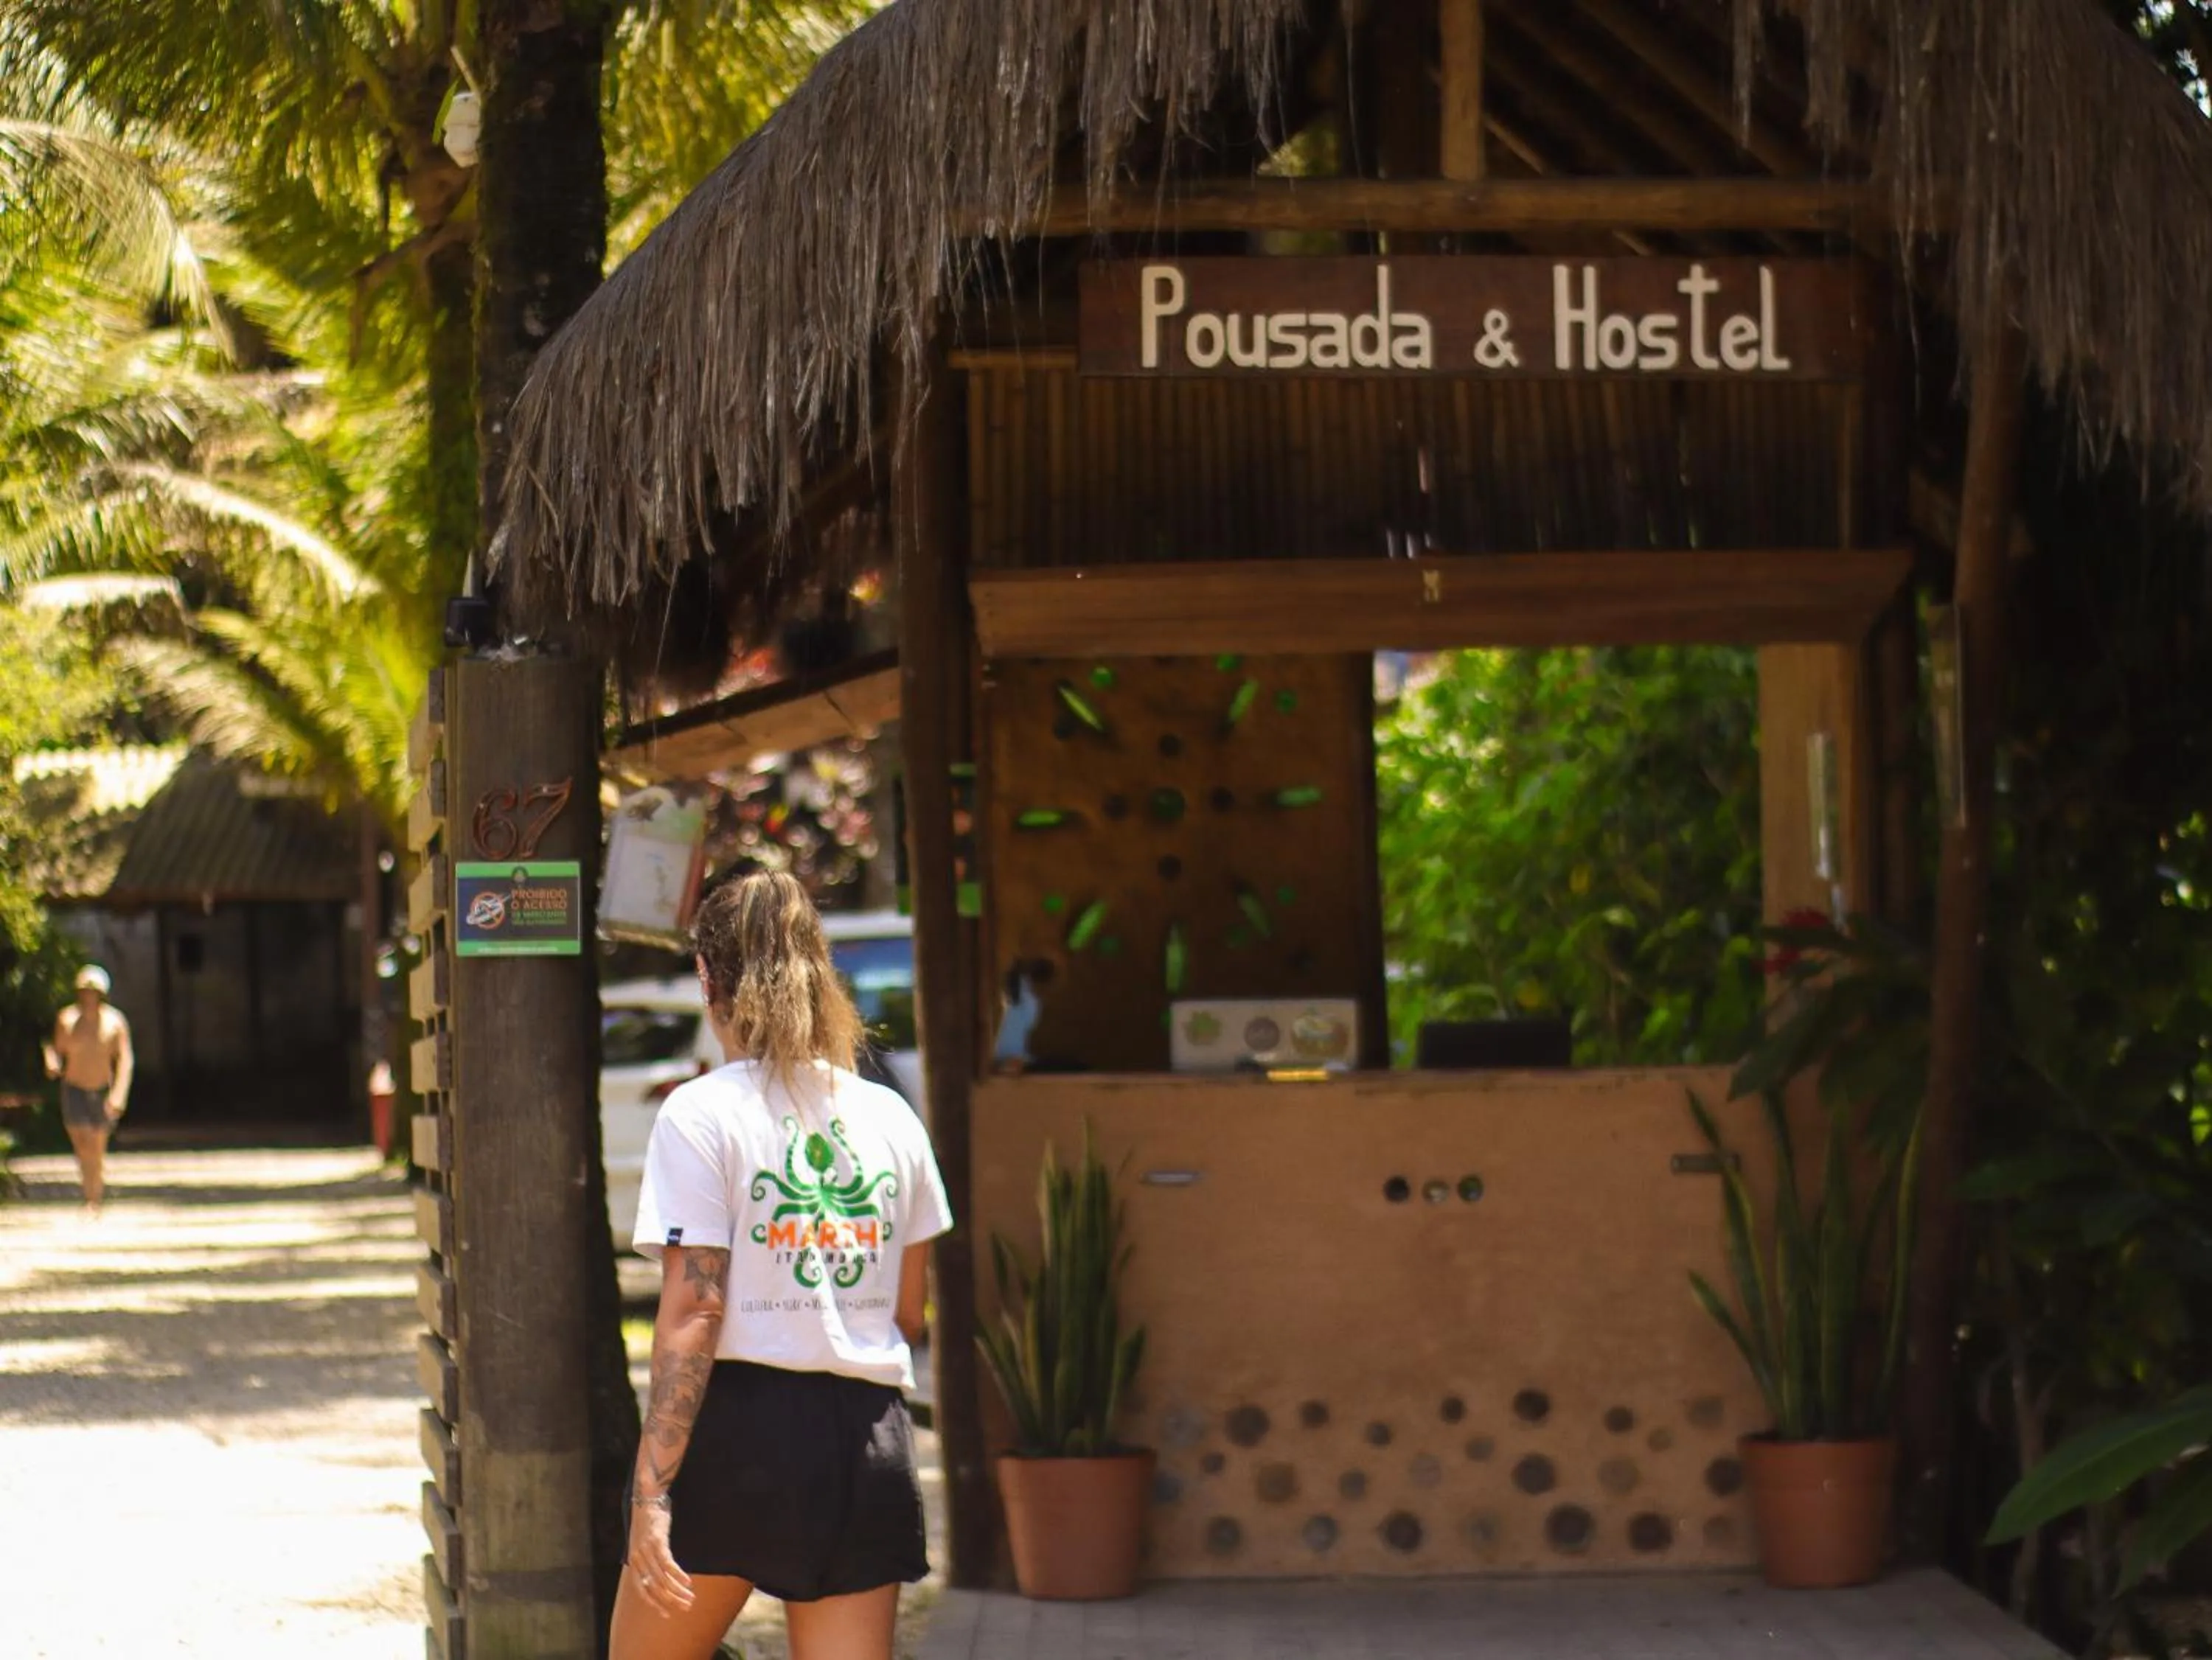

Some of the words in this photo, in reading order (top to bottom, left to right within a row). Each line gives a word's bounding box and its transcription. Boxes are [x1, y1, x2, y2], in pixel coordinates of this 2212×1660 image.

[1141, 264, 1433, 369] Pousada
[1474, 308, 1520, 369] &
[1554, 264, 1790, 371] Hostel
[472, 776, 573, 860] 67
